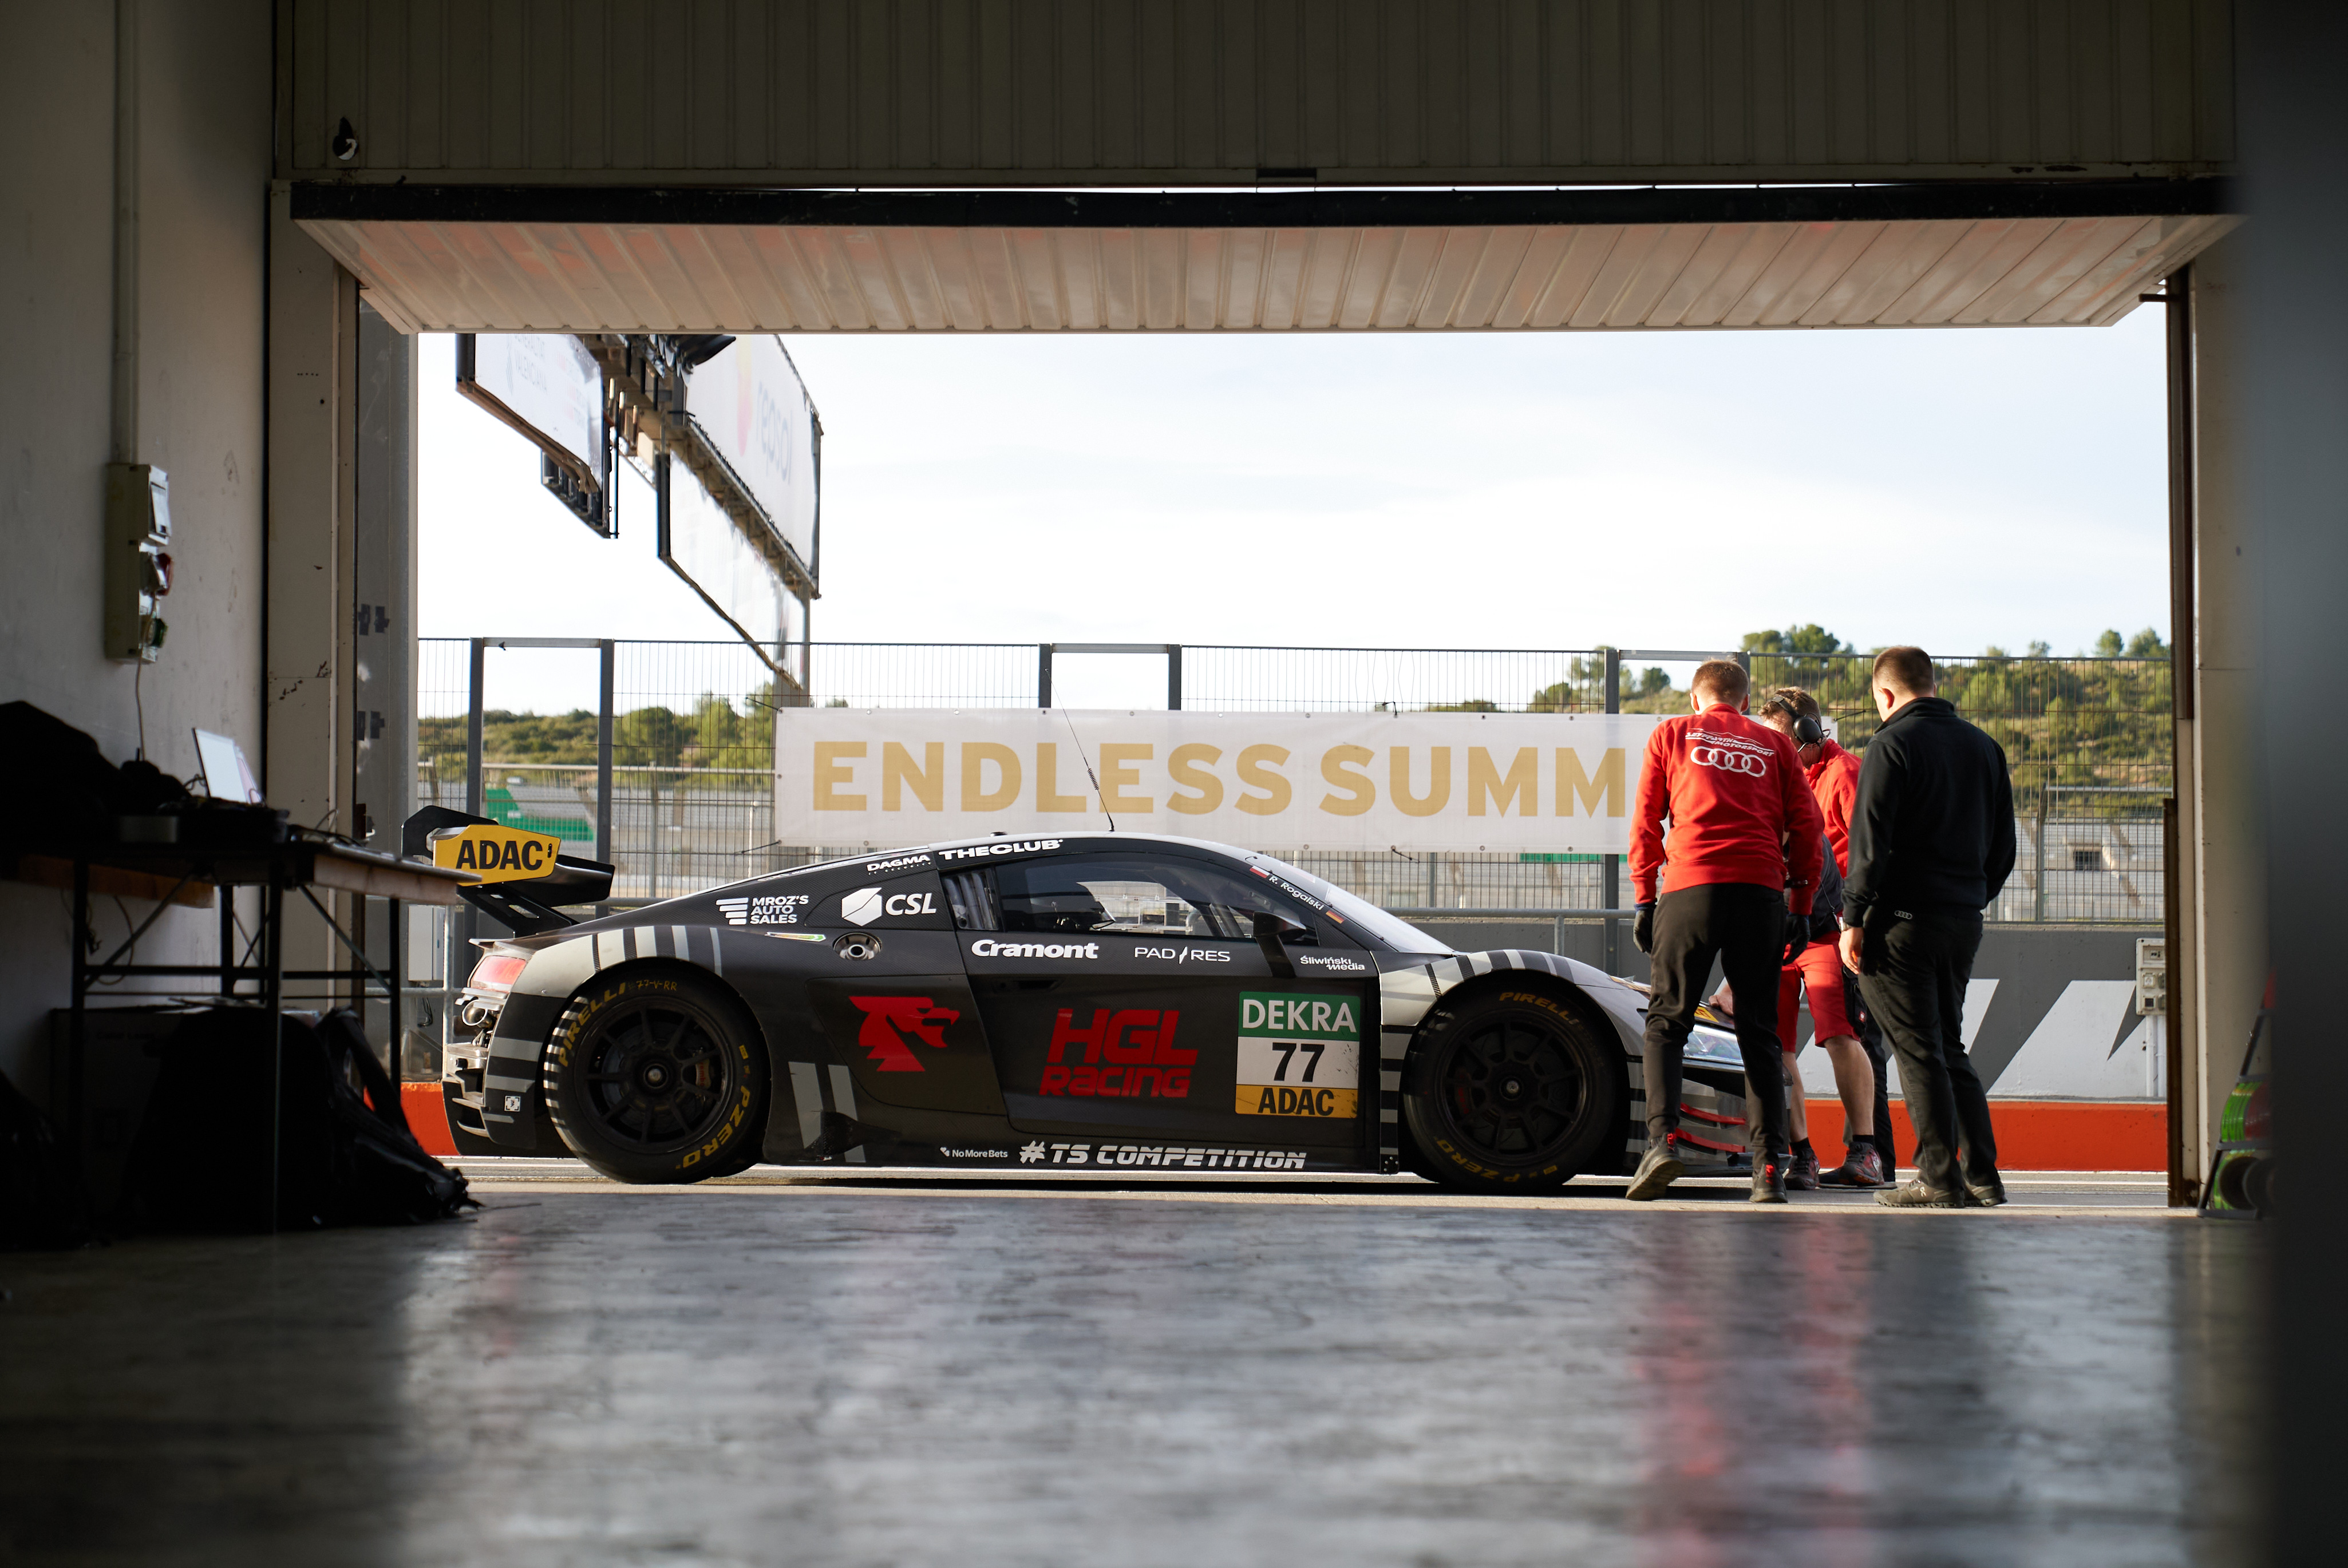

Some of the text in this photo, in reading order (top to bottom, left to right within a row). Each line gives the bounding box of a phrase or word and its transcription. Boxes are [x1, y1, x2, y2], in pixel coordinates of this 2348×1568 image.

[756, 381, 793, 486] repsol
[1716, 741, 1774, 757] MOTORSPORT
[813, 741, 1647, 819] ENDLESS SUMM
[456, 840, 543, 870] ADAC
[866, 855, 930, 872] DAGMA
[752, 895, 809, 906] MROZ'S
[886, 893, 937, 916] CSL
[1268, 876, 1325, 911] R. Rogalski
[750, 905, 794, 915] AUTO
[750, 914, 797, 924] SALES
[971, 939, 1099, 959] Cramont
[1326, 961, 1365, 971] media
[1242, 999, 1357, 1033] DEKRA
[1499, 992, 1580, 1025] PIRELLI
[558, 982, 626, 1067] PIRELLI
[1046, 1008, 1198, 1066] HGL
[1271, 1042, 1326, 1083] 77
[1258, 1087, 1335, 1116] ADAC
[1096, 1145, 1307, 1169] COMPETITION
